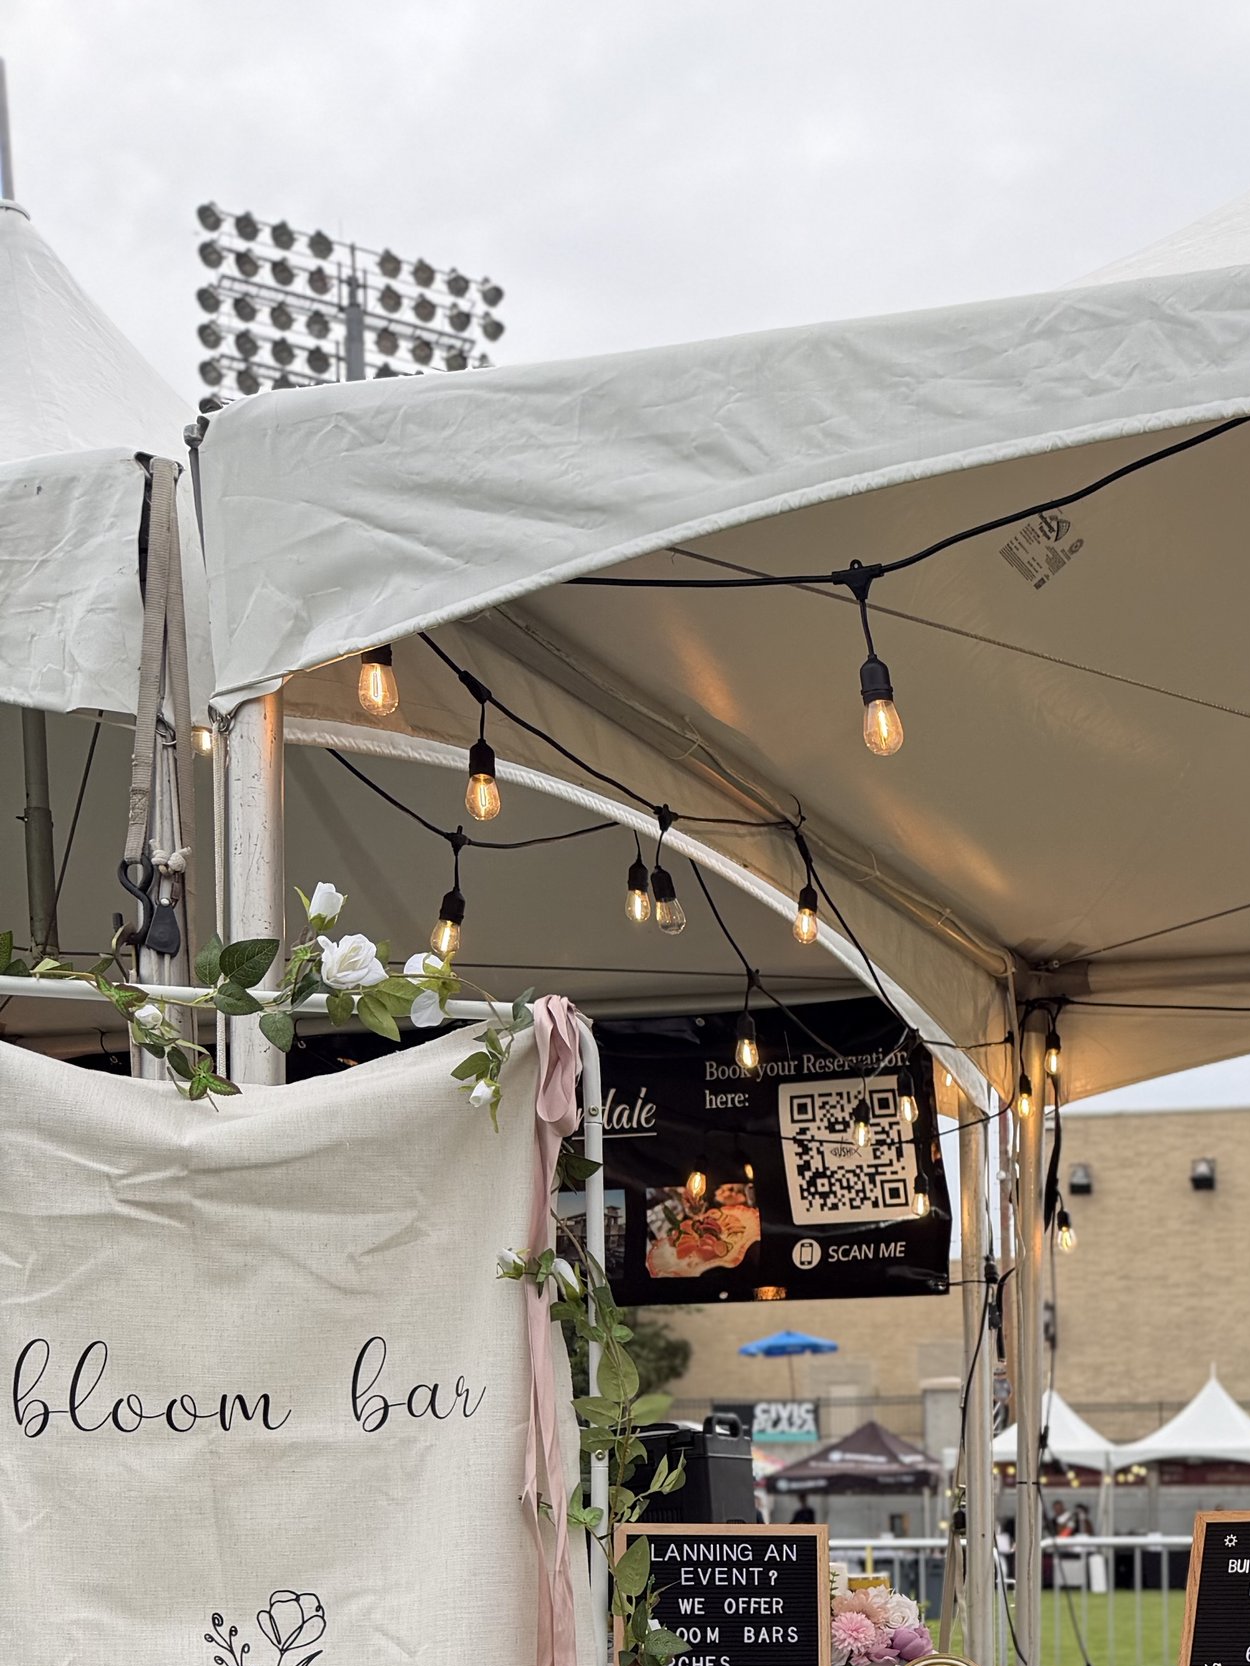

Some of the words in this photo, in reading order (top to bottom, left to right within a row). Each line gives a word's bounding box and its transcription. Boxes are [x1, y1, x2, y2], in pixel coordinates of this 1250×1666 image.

[757, 1059, 798, 1081] your
[803, 1048, 910, 1074] Reservation
[705, 1089, 749, 1109] here:
[577, 1087, 656, 1131] dale
[828, 1243, 874, 1262] SCAN
[879, 1241, 906, 1258] ME
[13, 1338, 291, 1438] bloom
[352, 1336, 486, 1432] bar
[754, 1402, 815, 1418] CIVIC
[650, 1543, 753, 1562] LANNING
[764, 1543, 797, 1562] AN
[681, 1567, 778, 1586] EVENT?
[678, 1597, 705, 1614] WE
[724, 1597, 783, 1614] OFFER
[675, 1627, 719, 1643] OOM
[744, 1626, 798, 1643] BARS
